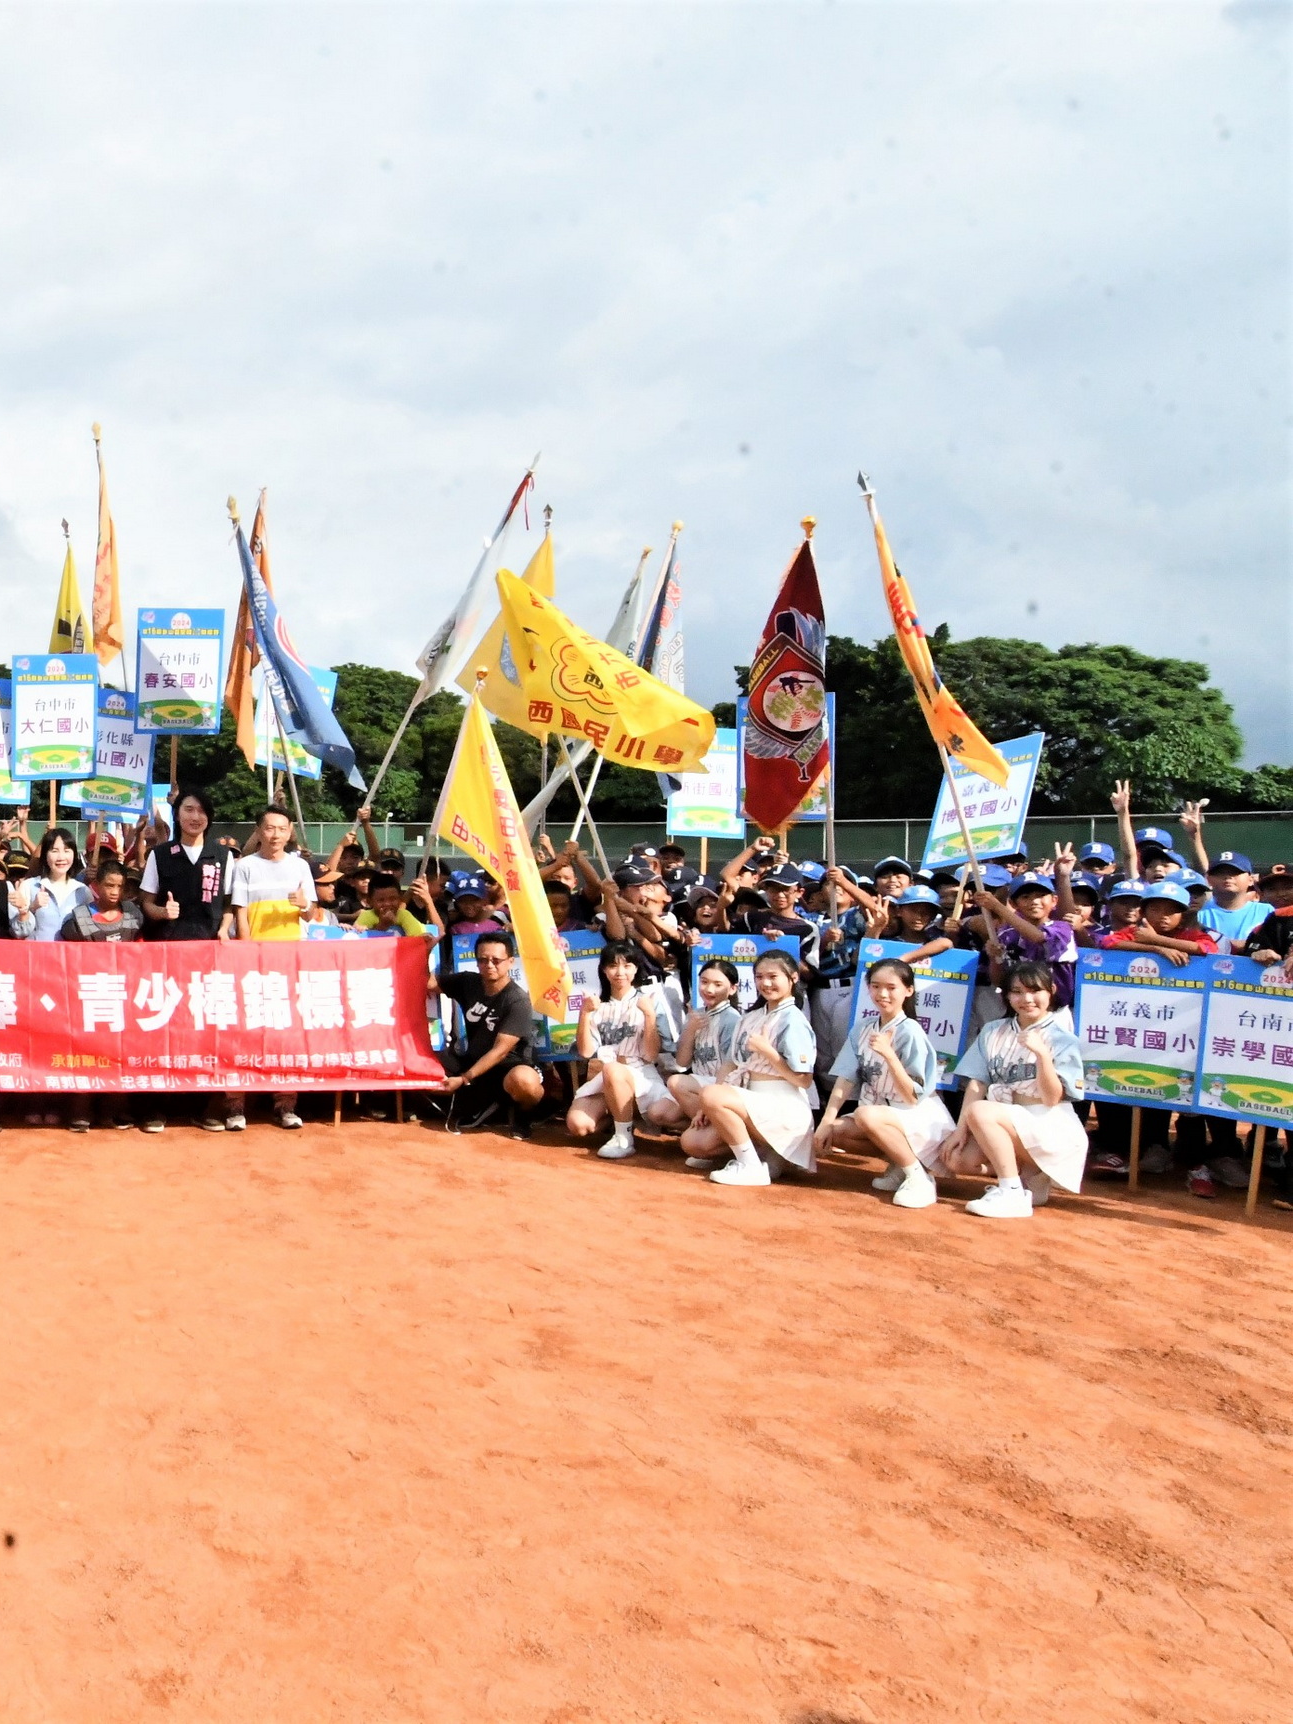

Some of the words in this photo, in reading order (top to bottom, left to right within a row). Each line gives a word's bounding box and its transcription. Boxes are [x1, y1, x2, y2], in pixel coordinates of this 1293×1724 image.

[159, 652, 200, 666] 台中市
[748, 647, 780, 692] ASEBALL
[144, 673, 213, 689] 春安國小
[35, 698, 76, 711] 台中市
[21, 717, 89, 734] 大仁國小
[96, 749, 144, 769] 山國小
[1144, 827, 1157, 838] B
[1091, 843, 1103, 854] B
[1219, 851, 1233, 861] B
[673, 869, 682, 880] J
[772, 864, 784, 875] J
[695, 875, 704, 886] J
[1130, 965, 1157, 974] 2024
[1109, 1000, 1176, 1021] 嘉義市
[1086, 1024, 1196, 1053] 世賢國小
[1114, 1083, 1165, 1097] BASEBALL
[1238, 1100, 1293, 1116] BASEBALL
